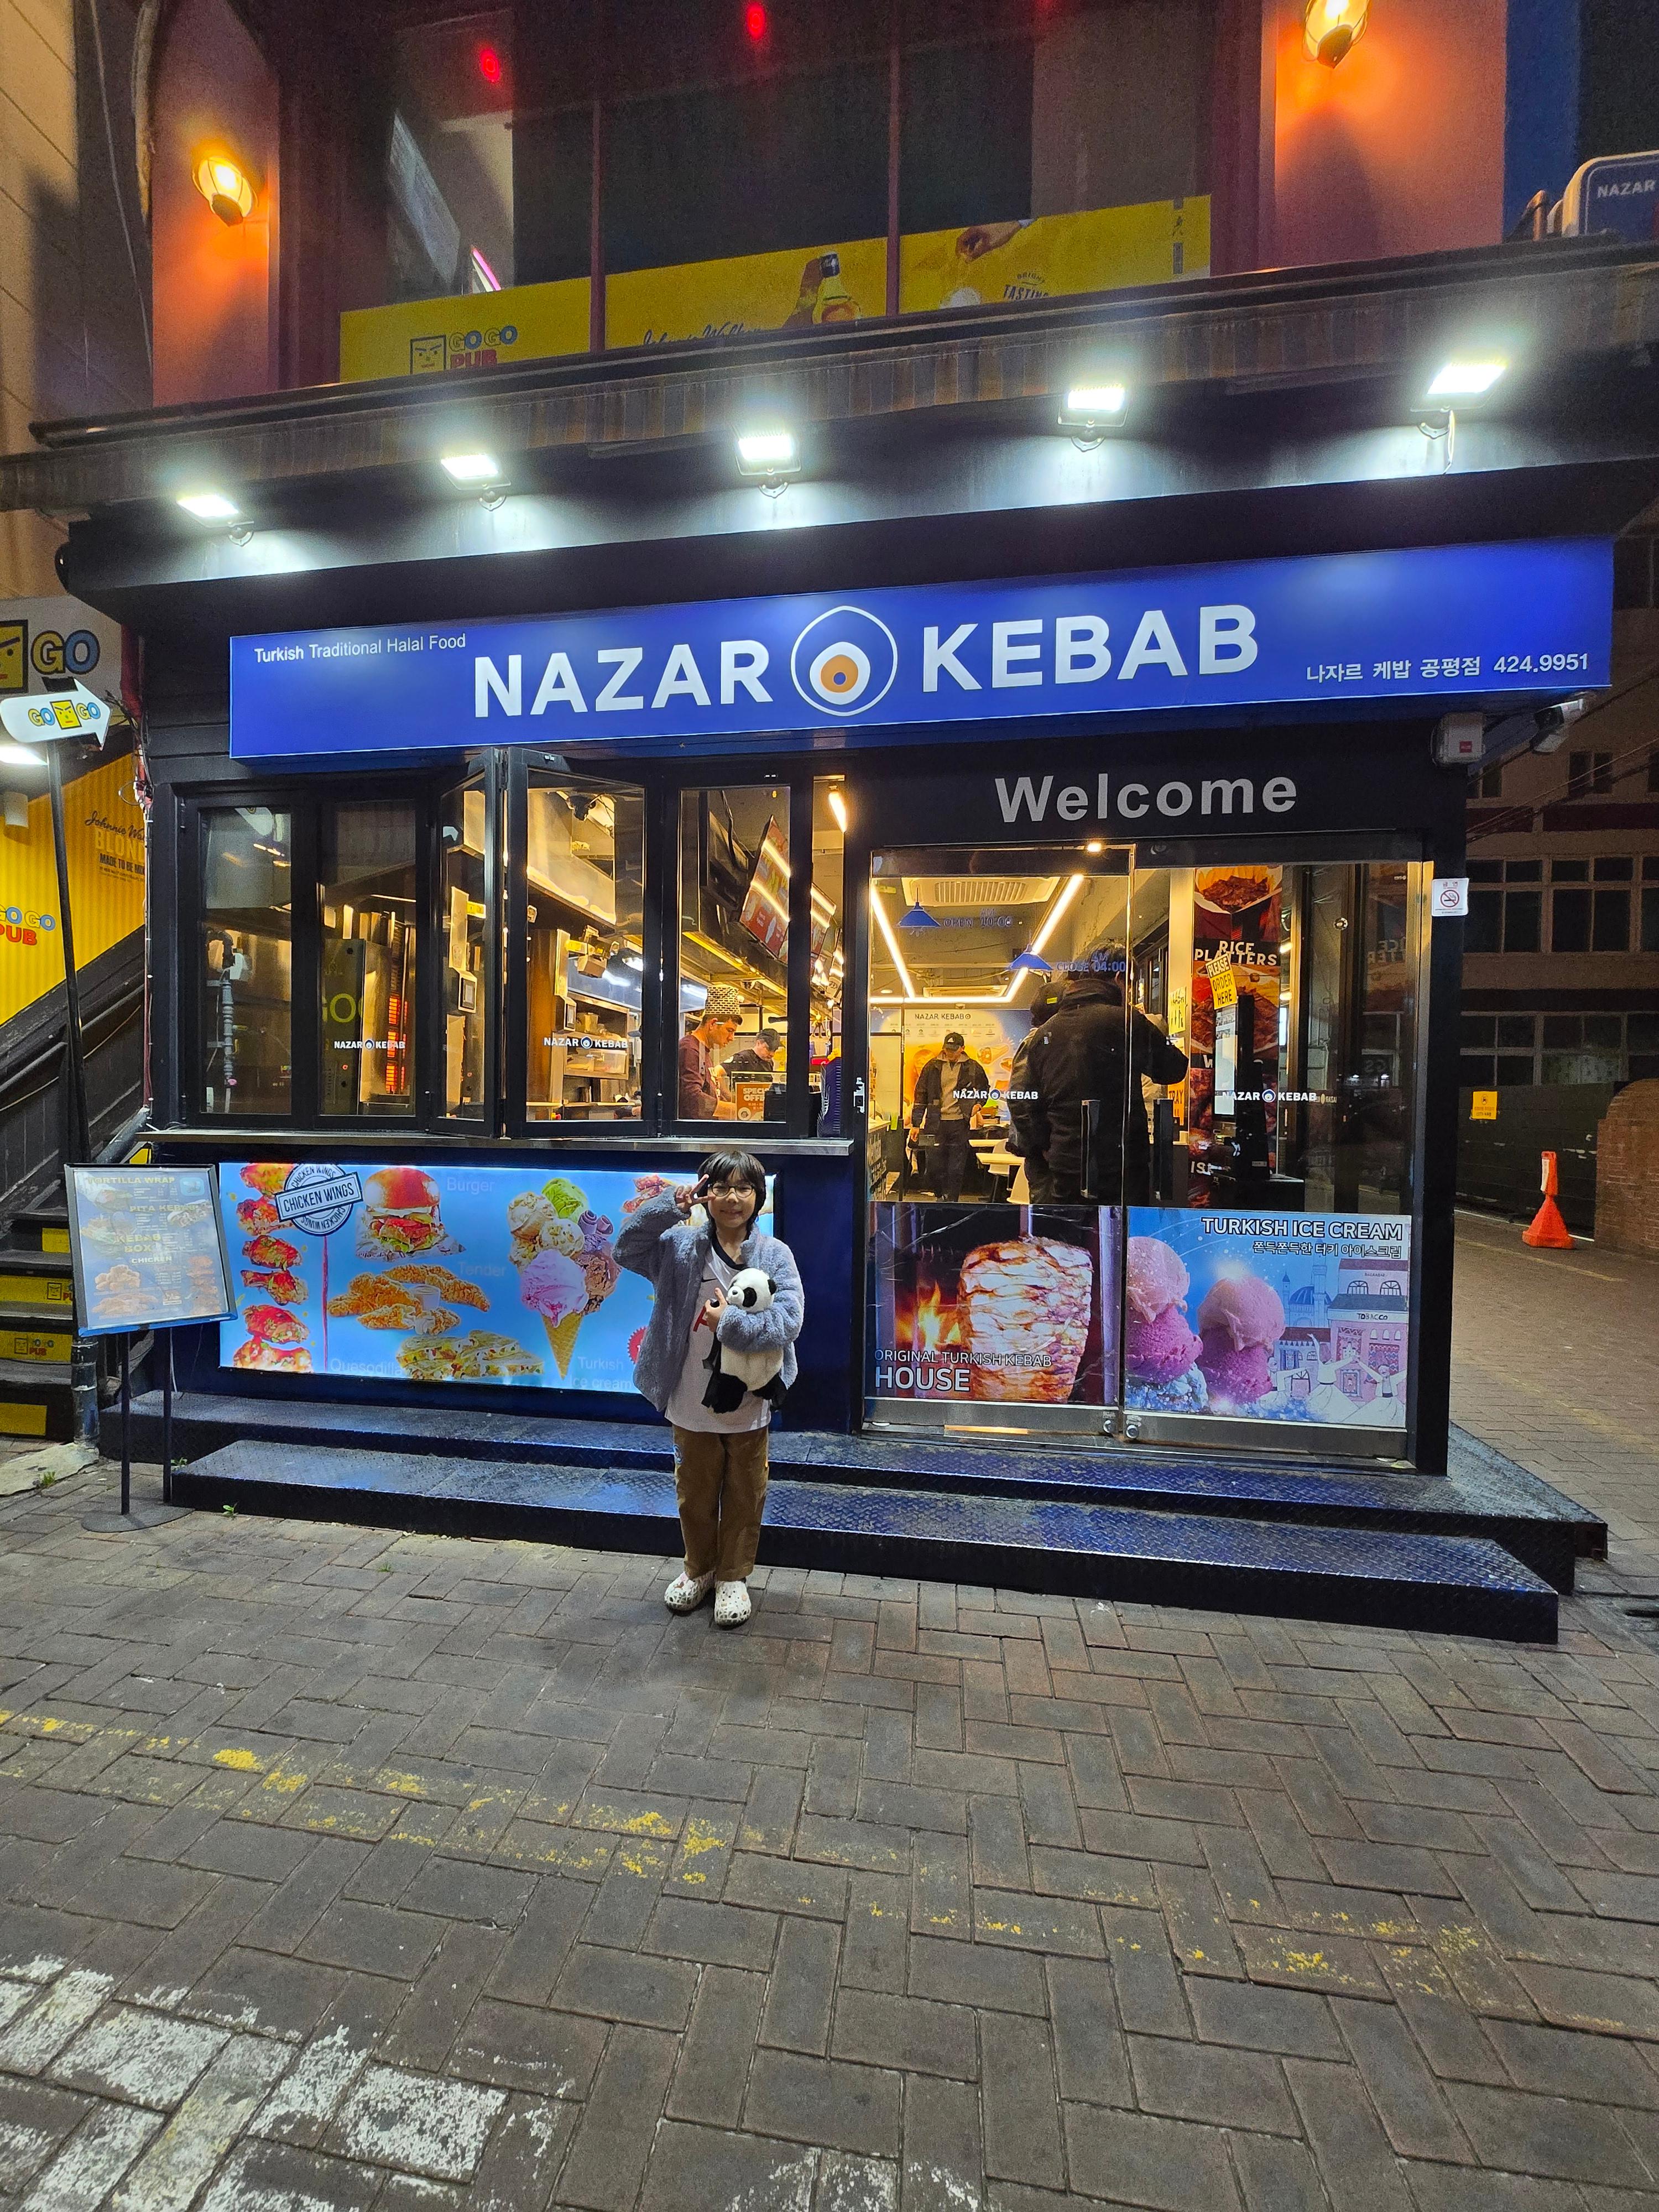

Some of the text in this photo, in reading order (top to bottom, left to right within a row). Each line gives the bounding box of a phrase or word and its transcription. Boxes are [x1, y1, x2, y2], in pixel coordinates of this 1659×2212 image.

[1597, 180, 1656, 198] NAZAR
[450, 349, 497, 369] PUB
[30, 629, 101, 675] GO
[254, 633, 466, 663] Turkish Traditional Halal Food
[475, 604, 1258, 718] NAZAR KEBAB
[1306, 653, 1588, 683] 나자르 케밥 공평점 424.9951
[28, 702, 101, 726] GO GO
[995, 773, 1297, 823] Welcome
[85, 811, 127, 835] Johnnie
[1219, 940, 1255, 954] RICE
[1056, 962, 1089, 972] CLOSE
[1207, 957, 1231, 978] PLEASE
[1212, 973, 1233, 992] ORDER
[1217, 989, 1233, 1006] HERE
[334, 1040, 405, 1049] NAZAR KEBAB
[544, 1037, 628, 1048] NAZAR KEBAB
[953, 1090, 1038, 1100] NAZAR KEBAB
[1222, 1092, 1260, 1100] NAZAR
[1278, 1092, 1316, 1101] KEBAB
[447, 1177, 495, 1194] Burger
[283, 1182, 354, 1213] CHICKEN WINGS
[1201, 1217, 1403, 1240] TURKISH ICE CREAM
[124, 1244, 152, 1253] BOX
[1253, 1241, 1402, 1259] 쫀득쫀득한 터키 아이스크림
[132, 1256, 172, 1264] CHICKEN
[577, 1357, 624, 1371] Turkish
[874, 1349, 1052, 1368] ORIGINAL TURKISH KEBAB
[591, 1378, 632, 1390] cream
[874, 1366, 971, 1392] HOUSE
